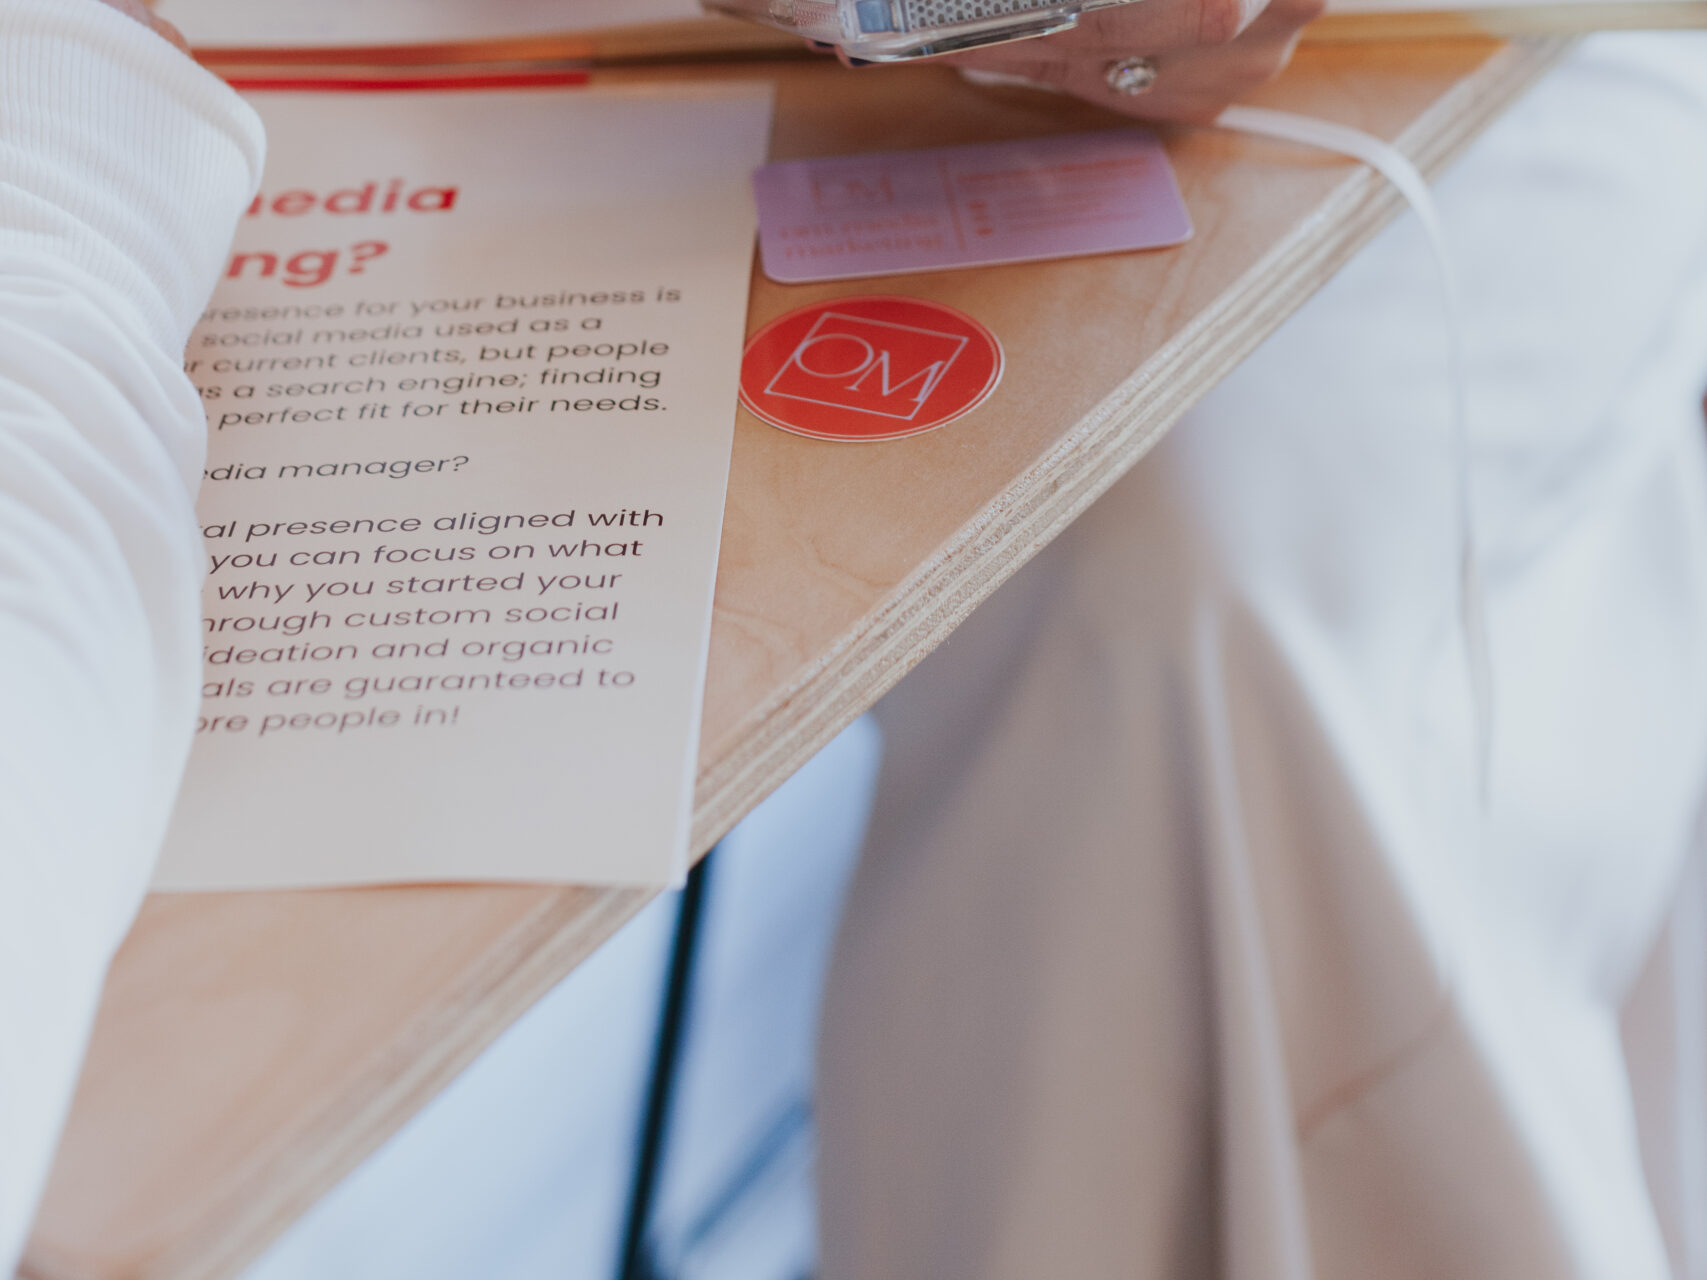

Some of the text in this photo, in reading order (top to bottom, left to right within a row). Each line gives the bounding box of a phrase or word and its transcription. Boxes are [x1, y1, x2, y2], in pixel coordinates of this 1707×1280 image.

[246, 178, 459, 219] edia
[226, 240, 391, 288] ng?
[355, 301, 397, 316] for
[410, 297, 483, 317] your
[494, 290, 646, 310] business
[655, 287, 682, 303] is
[202, 317, 603, 348] social media used as a
[211, 353, 337, 374] current
[348, 348, 466, 367] clients,
[478, 344, 537, 362] but
[546, 339, 670, 363] people
[795, 332, 946, 403] OM
[232, 385, 256, 399] a
[266, 376, 386, 398] search
[397, 372, 528, 395] engine;
[540, 367, 662, 389] finding
[216, 394, 668, 432] perfect fit for their needs.
[202, 455, 470, 483] dia manager?
[198, 508, 664, 544] al presence aligned with
[208, 539, 644, 576] you can focus on what
[217, 571, 623, 605] why you started your
[343, 607, 491, 628] custom
[504, 601, 619, 624] social
[371, 637, 450, 659] and
[461, 634, 614, 662] organic
[201, 668, 636, 700] als are guaranteed to
[258, 707, 401, 737] people
[413, 705, 460, 726] in!
